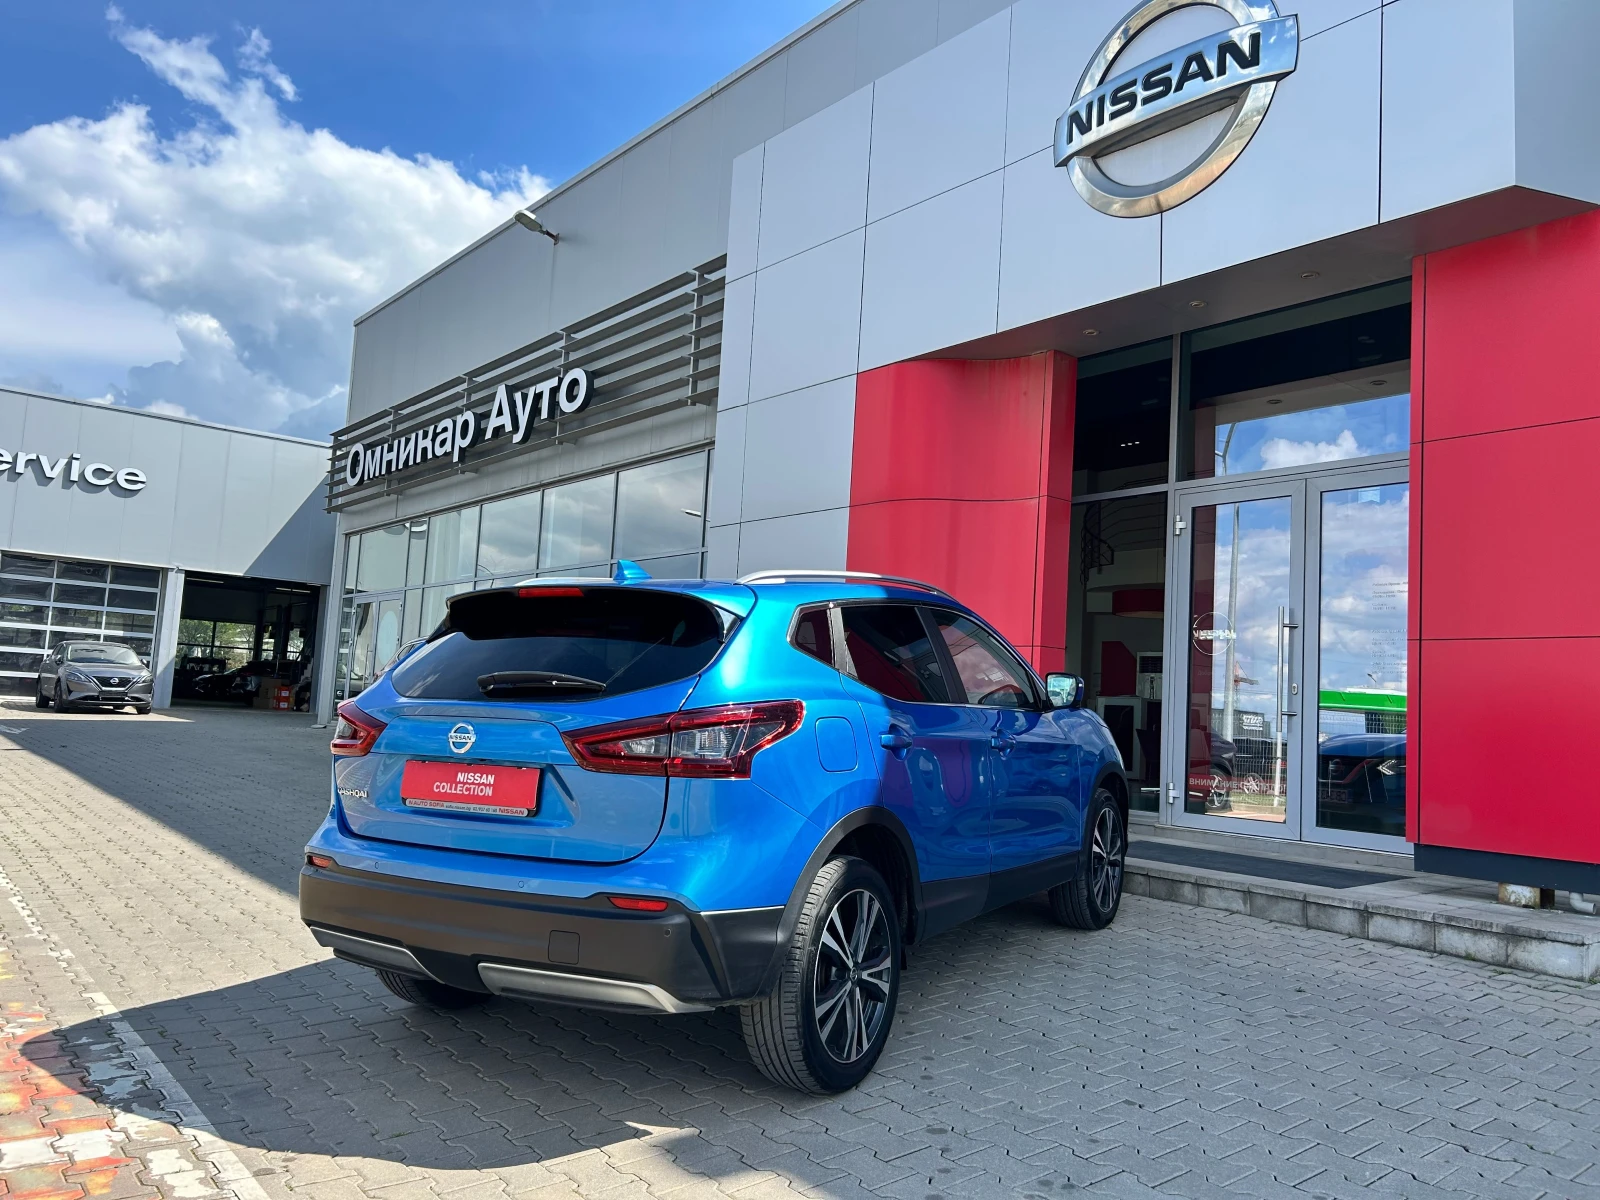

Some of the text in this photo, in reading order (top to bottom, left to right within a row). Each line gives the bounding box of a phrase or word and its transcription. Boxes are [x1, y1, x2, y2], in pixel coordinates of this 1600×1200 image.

[1067, 32, 1261, 146] NISSAN
[346, 367, 592, 487] Омникар Ауто
[449, 733, 472, 741] NISSAN
[456, 771, 496, 785] NISSAN
[1189, 777, 1239, 790] ВНИМАНИЕ
[433, 781, 494, 797] COLLECTION
